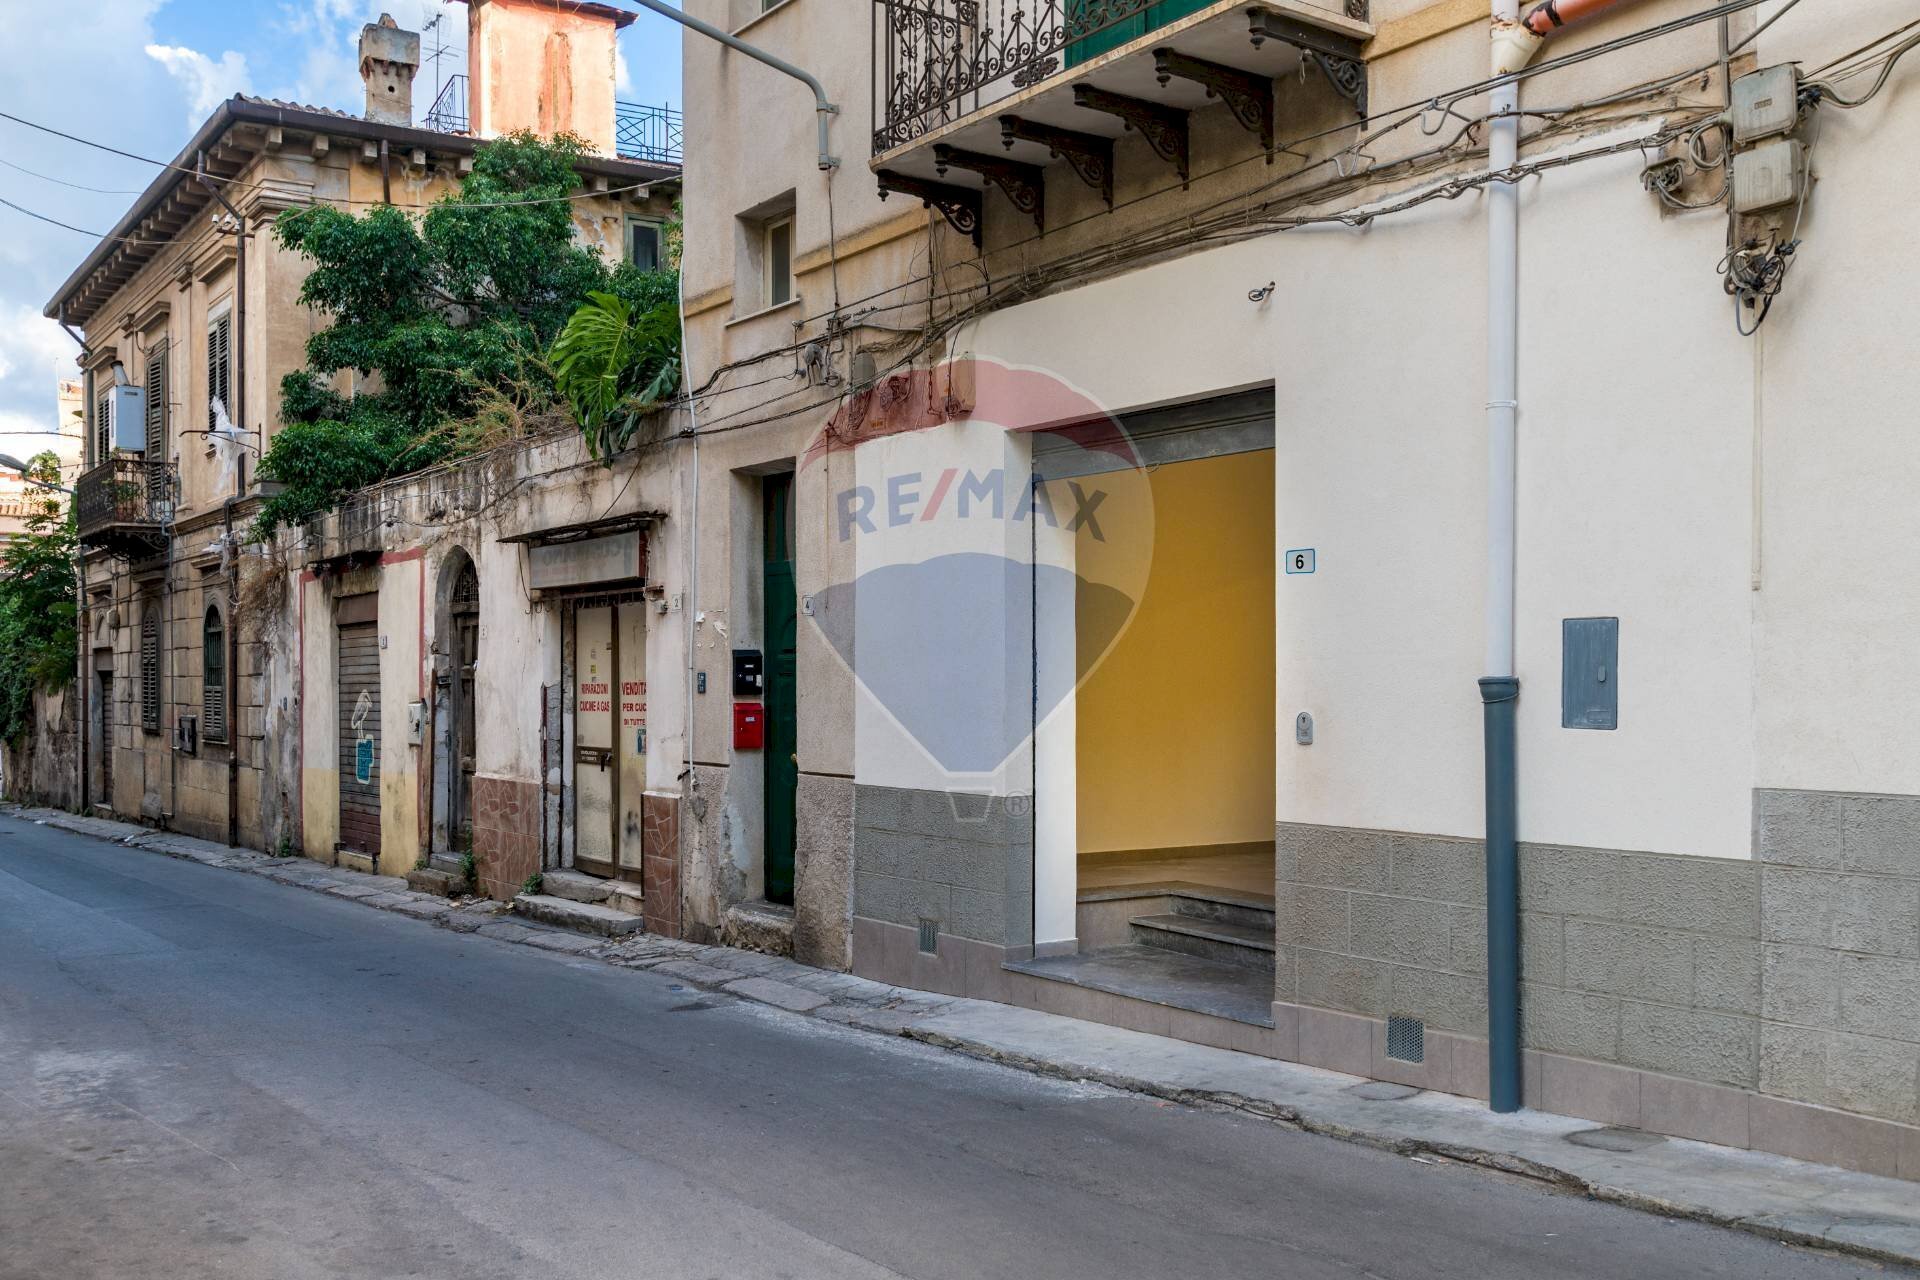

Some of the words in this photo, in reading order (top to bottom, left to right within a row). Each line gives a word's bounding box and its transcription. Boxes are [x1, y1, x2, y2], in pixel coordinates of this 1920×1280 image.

[1295, 554, 1304, 570] 6
[601, 701, 609, 711] GAS
[623, 703, 634, 711] PER
